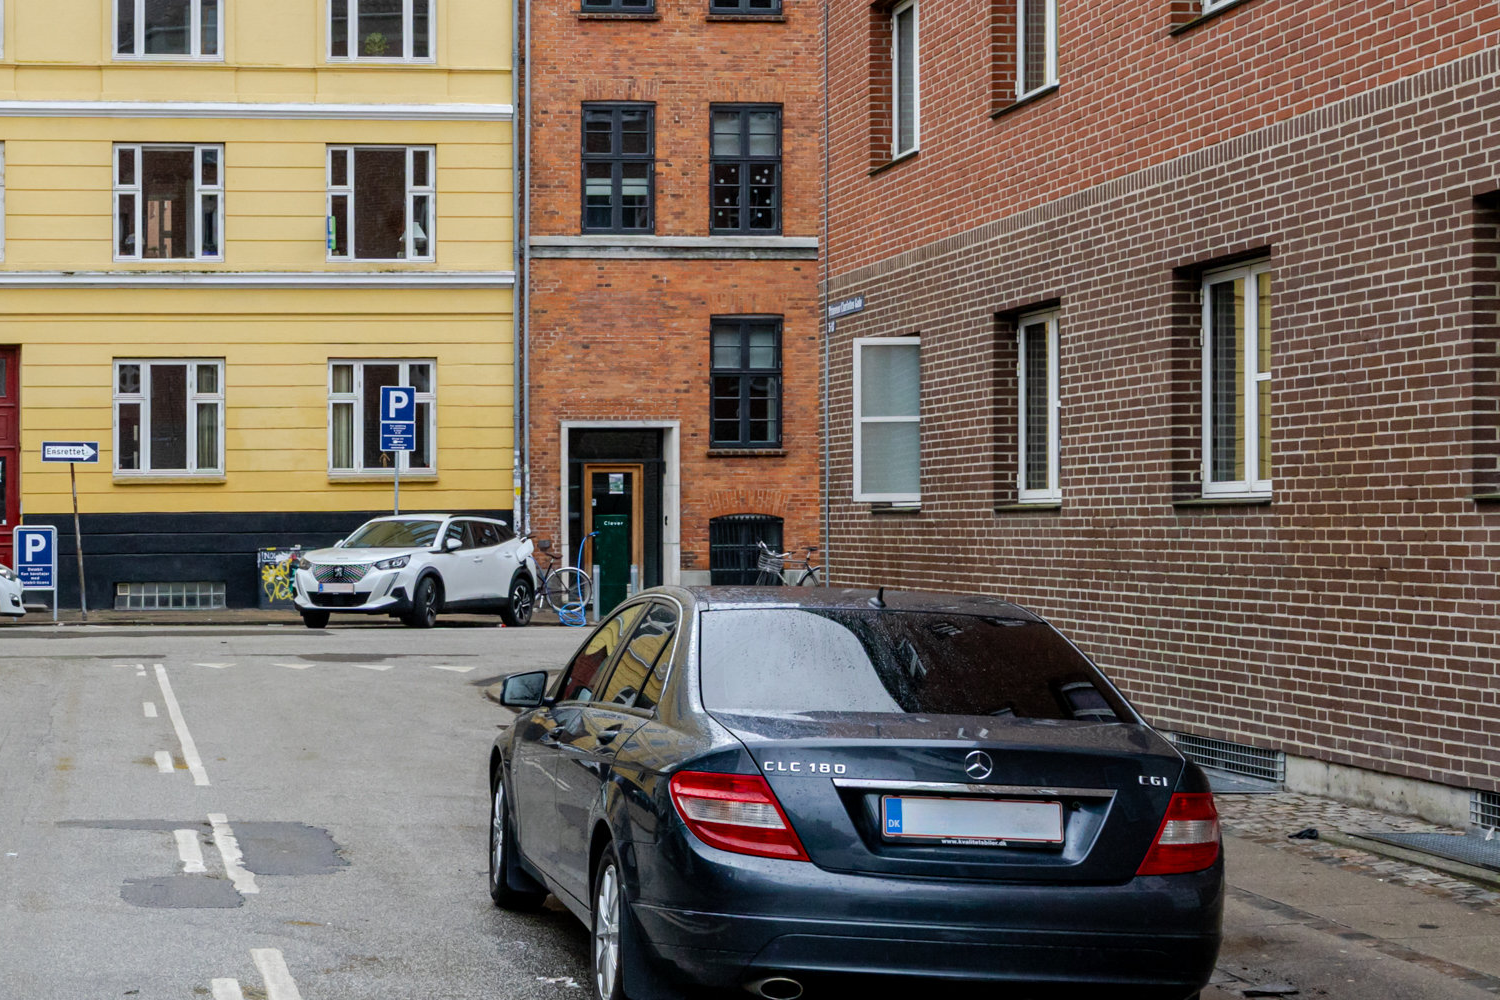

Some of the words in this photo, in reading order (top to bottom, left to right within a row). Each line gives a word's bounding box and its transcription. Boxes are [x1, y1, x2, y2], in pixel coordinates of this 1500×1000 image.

[389, 390, 409, 418] P
[25, 533, 46, 562] P
[809, 762, 846, 774] 180
[1138, 775, 1168, 787] CGI
[888, 819, 901, 828] DK
[941, 839, 1007, 847] www.kvalitetsbiler.dk
